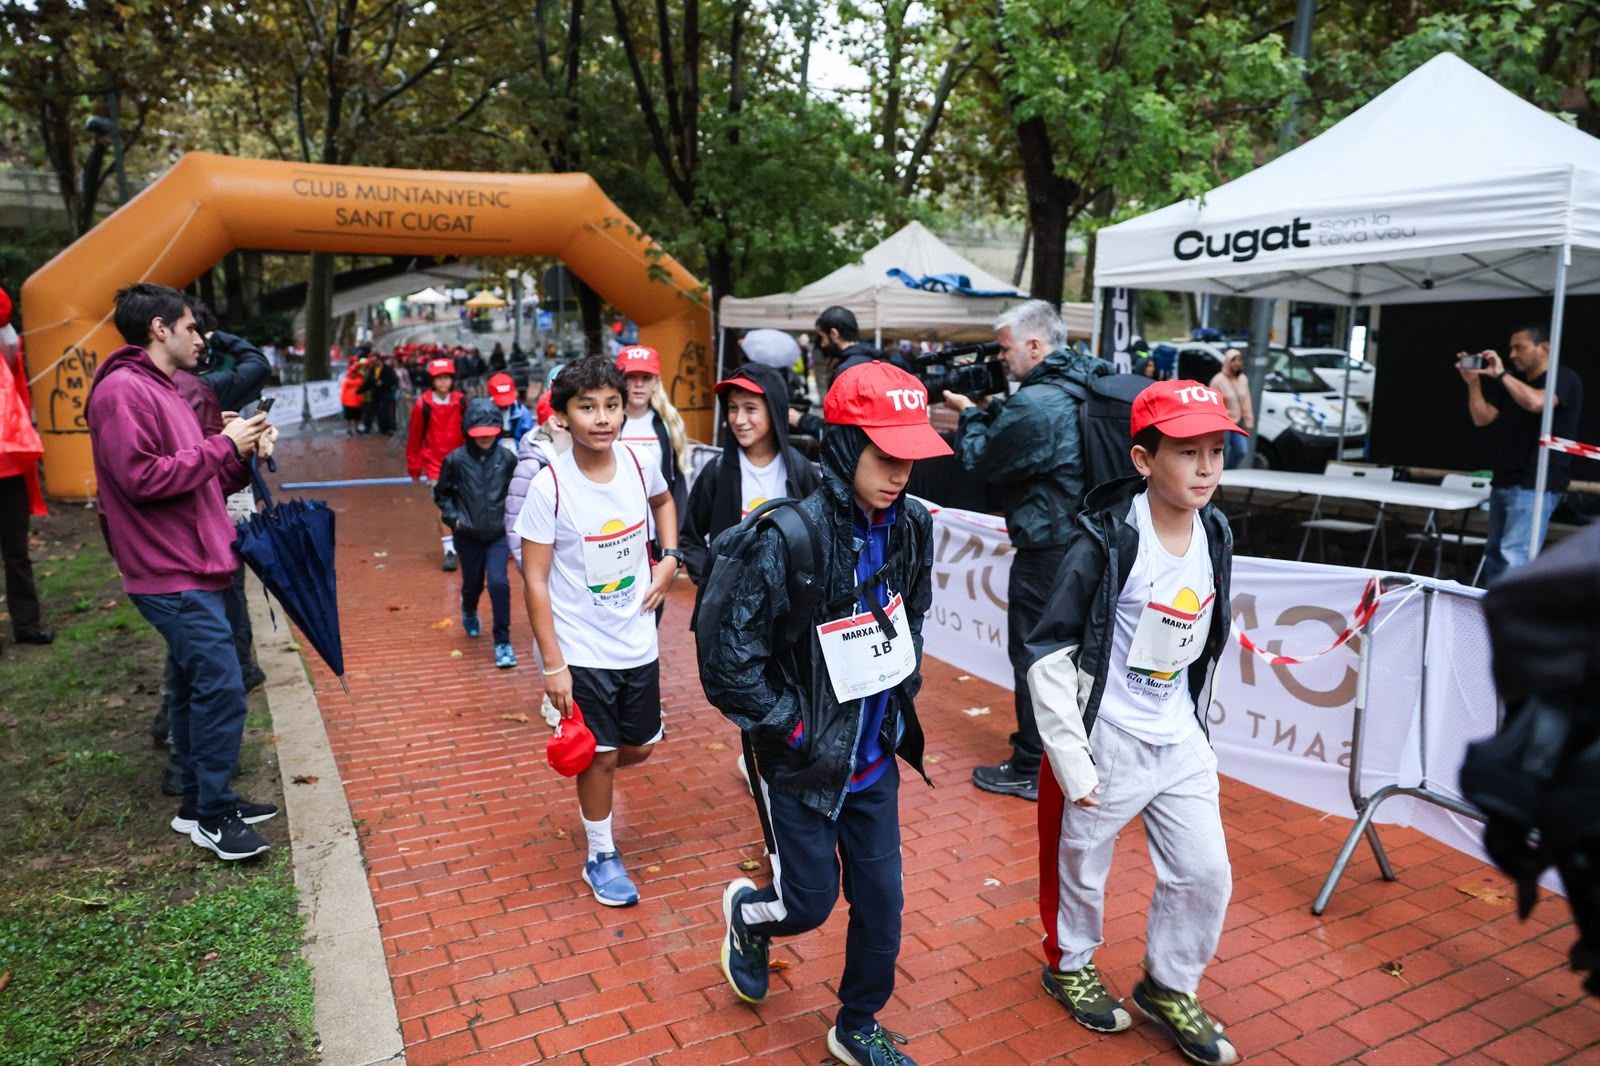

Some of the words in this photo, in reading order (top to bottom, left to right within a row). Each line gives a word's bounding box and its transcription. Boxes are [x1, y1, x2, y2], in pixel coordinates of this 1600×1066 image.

[292, 178, 348, 199] CLUB
[355, 183, 512, 209] MUNTANYENC
[335, 206, 394, 229] SANT
[400, 211, 475, 233] CUGAT
[1173, 216, 1312, 263] Cugat
[1374, 223, 1416, 240] veu
[626, 347, 650, 360] TOT
[885, 388, 926, 412] TOT
[1173, 385, 1219, 406] TOT
[616, 547, 630, 560] 2B
[1161, 616, 1193, 631] MARXA
[842, 626, 875, 642] MARXA
[1178, 633, 1194, 648] 1A
[870, 640, 893, 658] 1B
[1126, 672, 1143, 685] 67a
